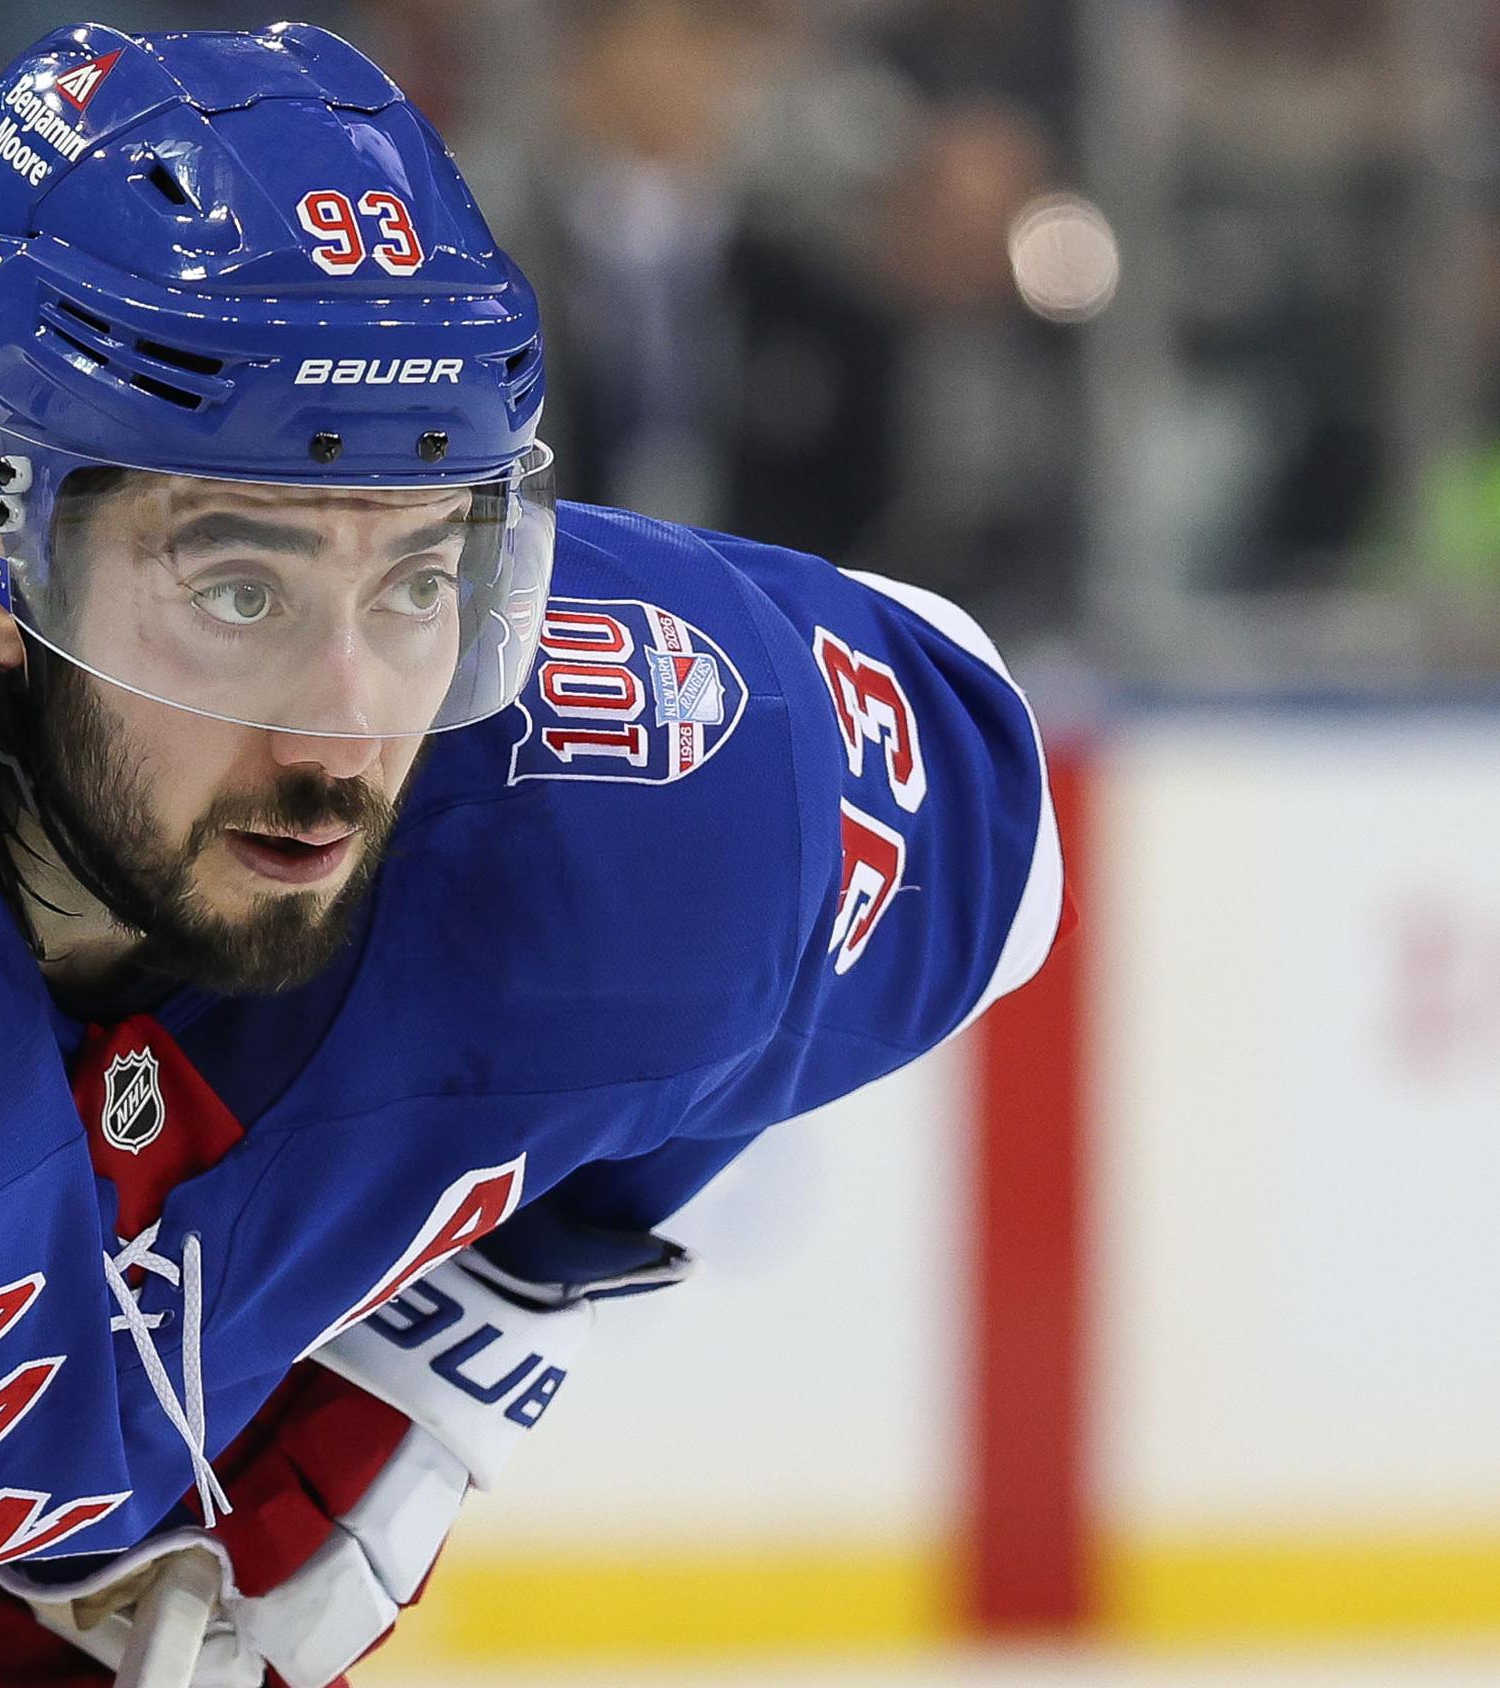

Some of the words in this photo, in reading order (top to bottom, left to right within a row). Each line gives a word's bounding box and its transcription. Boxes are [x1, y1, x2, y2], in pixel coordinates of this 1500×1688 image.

[5, 73, 89, 162] Benjamin
[295, 189, 425, 276] 93
[294, 359, 464, 385] BAUER
[660, 616, 681, 651] 2026
[538, 609, 649, 768] 100
[658, 656, 674, 686] YORK
[679, 657, 711, 710] RANGERS
[663, 688, 676, 717] NEW
[680, 726, 693, 764] 1926
[813, 625, 928, 976] 93
[116, 1074, 150, 1133] NHL
